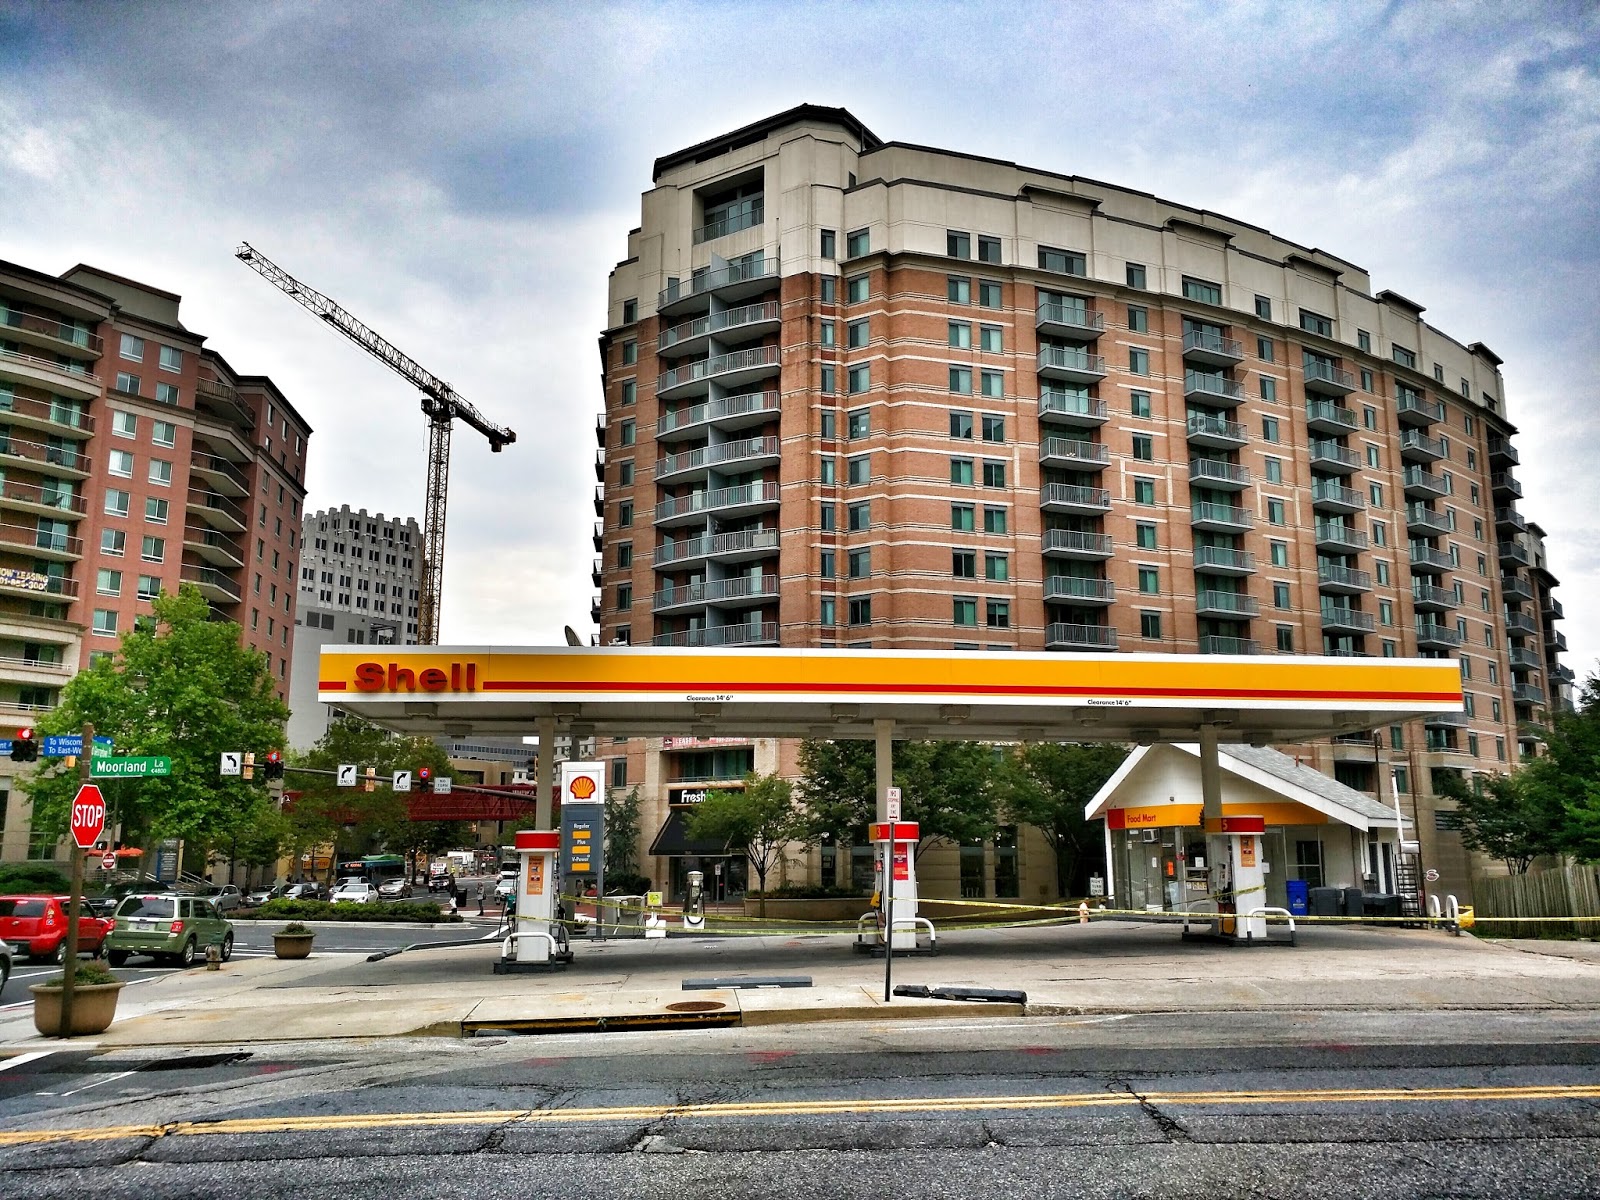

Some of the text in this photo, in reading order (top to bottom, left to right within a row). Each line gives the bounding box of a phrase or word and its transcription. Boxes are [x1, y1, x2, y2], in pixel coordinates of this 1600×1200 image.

[0, 567, 49, 583] OW LEASING
[354, 663, 476, 691] Shell
[96, 759, 164, 773] Moorland La
[73, 804, 103, 828] STOP
[1127, 813, 1156, 823] Food Mart
[876, 826, 881, 838] 3
[1222, 819, 1228, 831] 5
